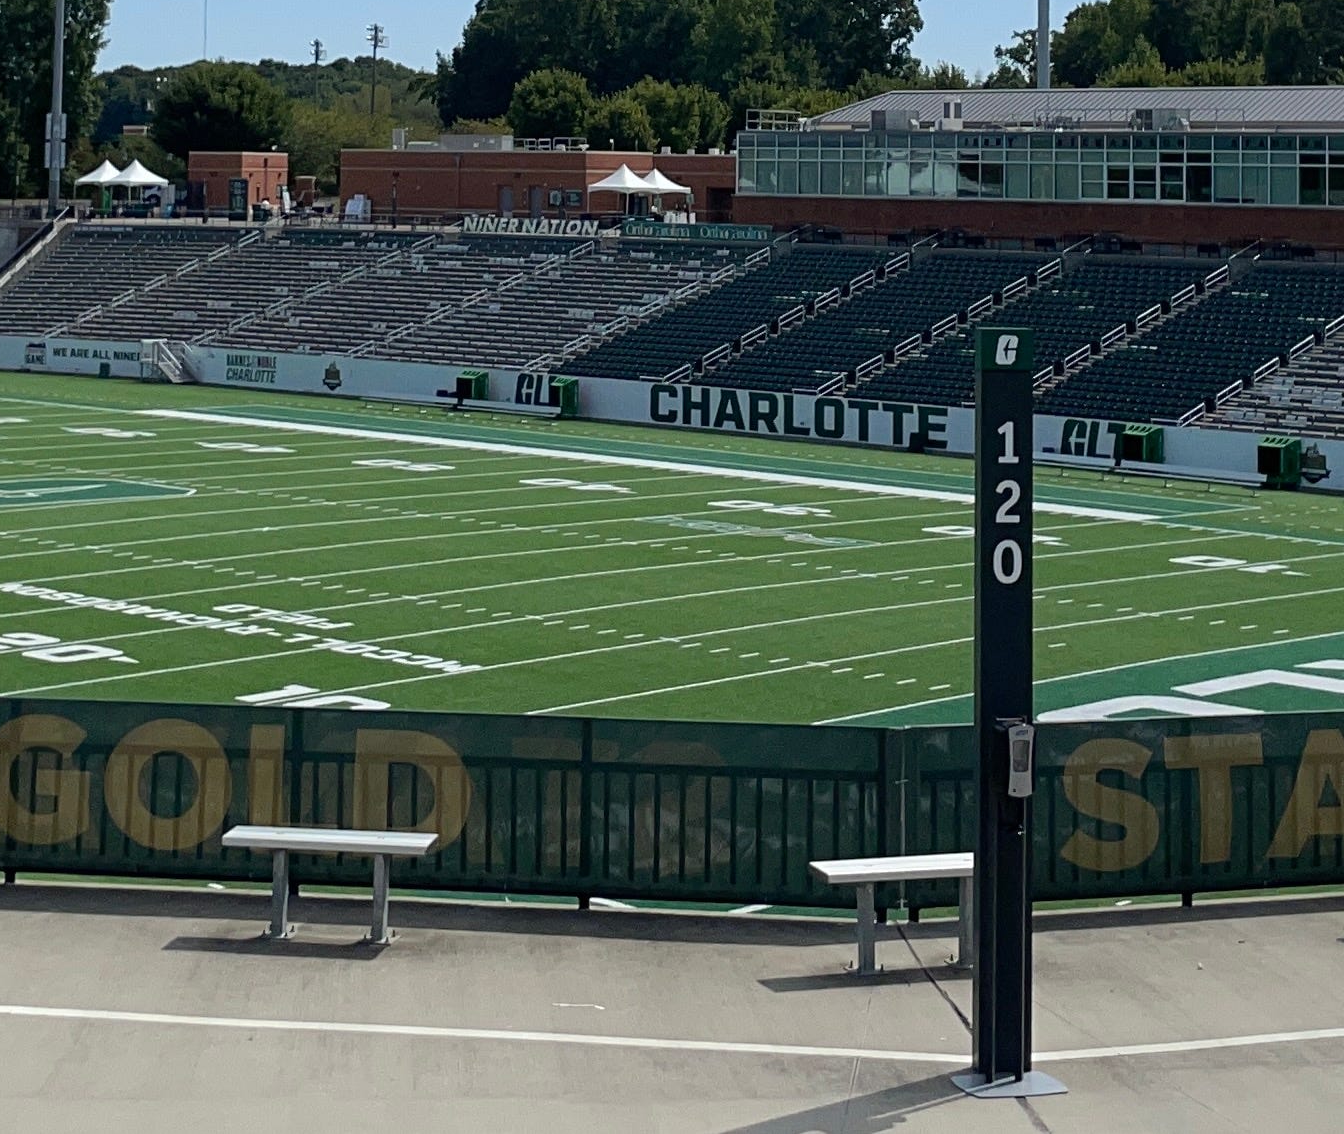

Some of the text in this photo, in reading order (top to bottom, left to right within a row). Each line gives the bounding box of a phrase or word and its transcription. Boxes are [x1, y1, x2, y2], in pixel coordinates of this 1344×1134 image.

[463, 216, 599, 237] NINER NATION
[53, 348, 141, 361] WE ARE ALL NINE
[226, 367, 277, 383] CHARLOTTE
[649, 384, 949, 449] CHARLOTTE
[993, 421, 1023, 584] 120
[212, 603, 354, 629] FIELD
